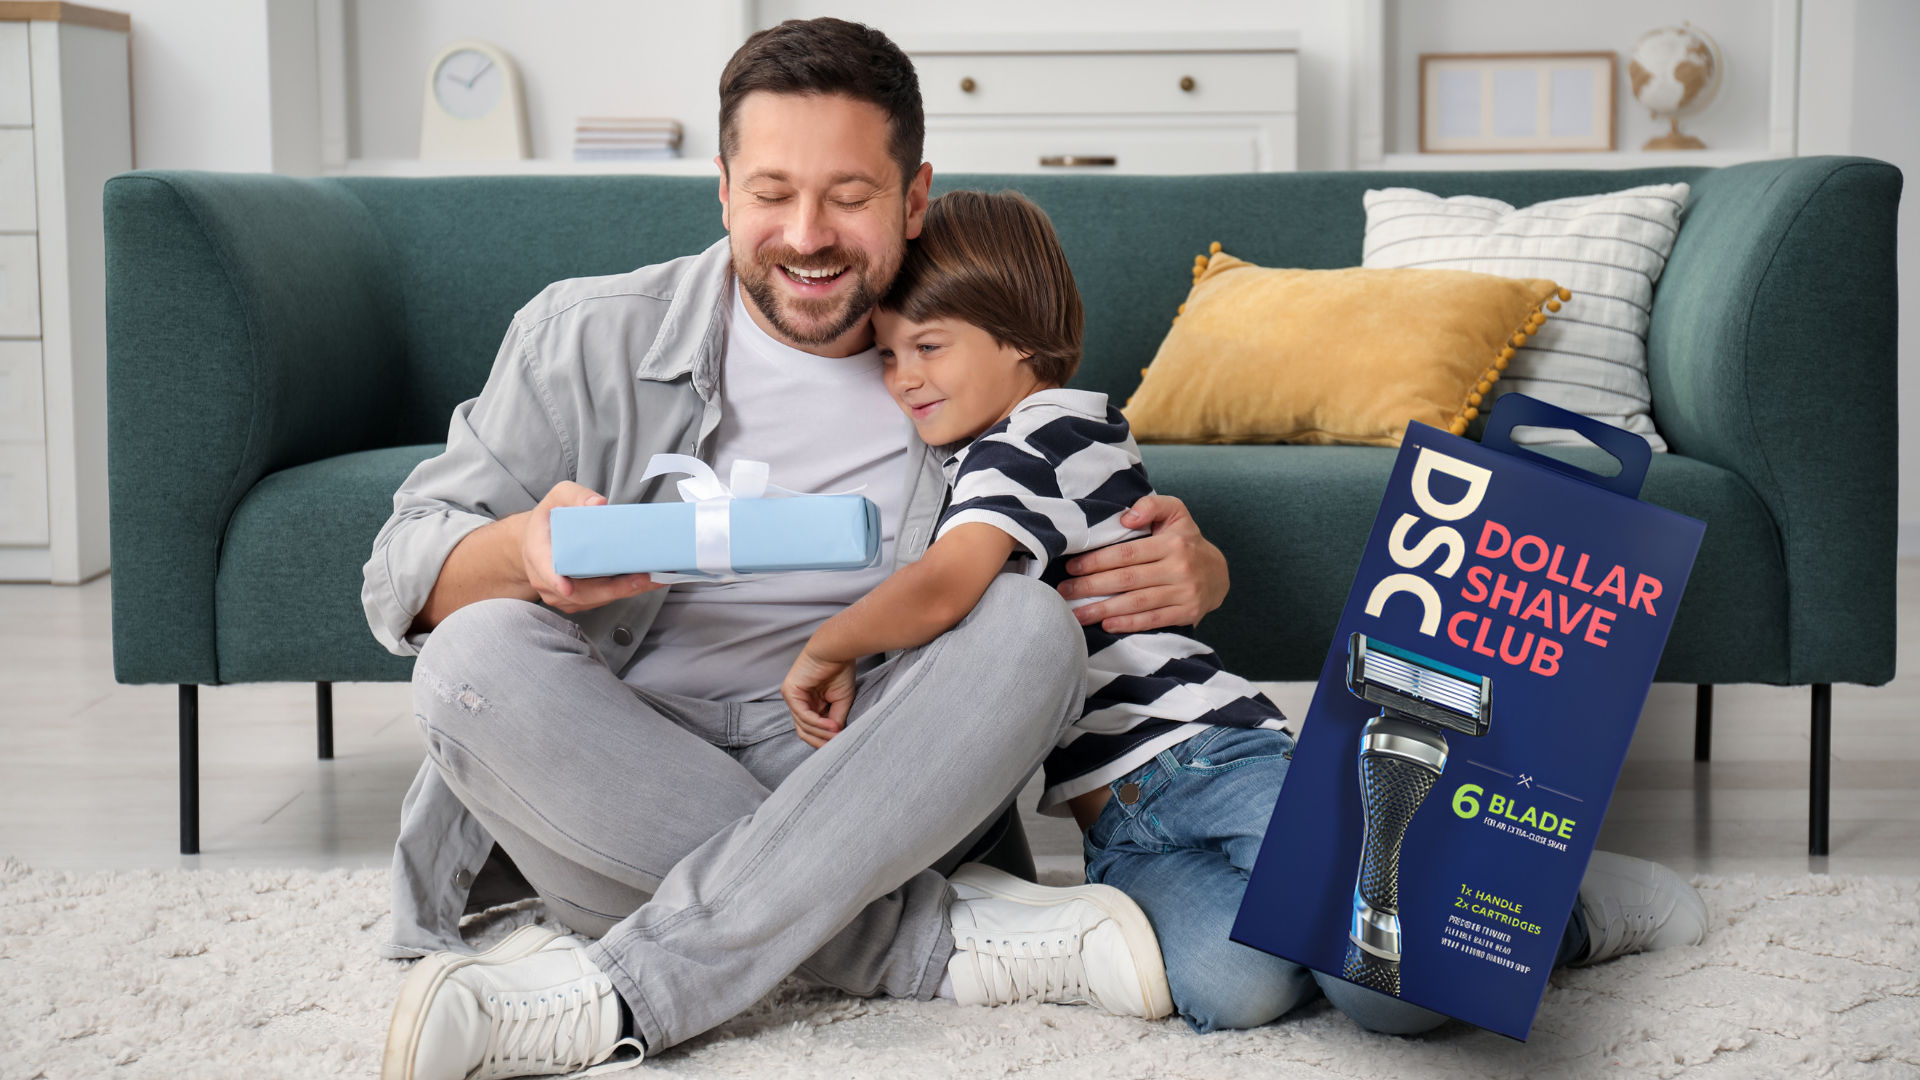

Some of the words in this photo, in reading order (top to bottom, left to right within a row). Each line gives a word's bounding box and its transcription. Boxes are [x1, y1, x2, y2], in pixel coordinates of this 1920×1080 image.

[1365, 447, 1492, 637] DSC
[1475, 520, 1663, 616] DOLLAR
[1461, 566, 1617, 648] SHAVE
[1447, 610, 1564, 677] CLUB
[1452, 783, 1484, 819] 6
[1488, 793, 1576, 839] BLADE
[1454, 897, 1469, 910] 2x
[1471, 904, 1542, 935] CARTRIDGES
[1461, 883, 1473, 896] 1x
[1475, 890, 1523, 914] HANDLE
